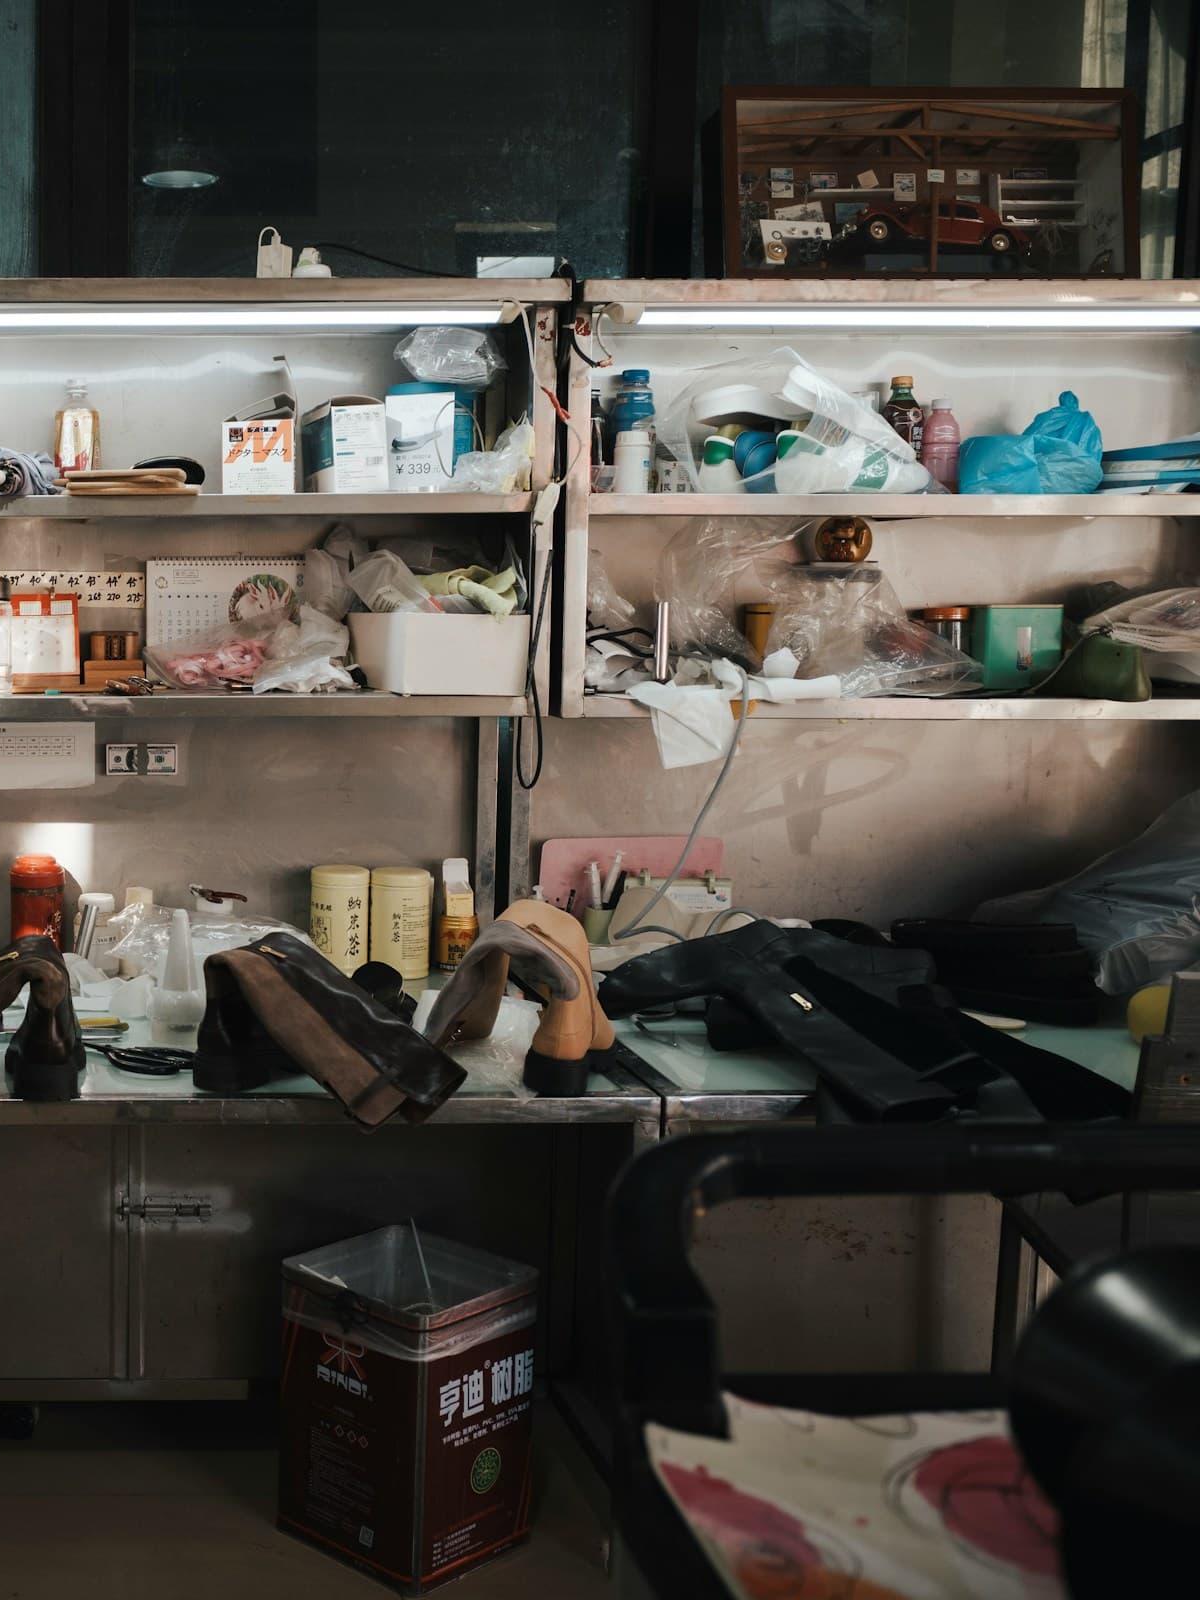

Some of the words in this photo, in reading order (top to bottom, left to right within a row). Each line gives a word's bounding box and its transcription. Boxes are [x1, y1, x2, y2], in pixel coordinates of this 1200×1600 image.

[229, 447, 288, 457] ドクターマスク
[408, 463, 431, 475] 339
[87, 592, 102, 602] 265
[106, 592, 121, 601] 270
[127, 592, 143, 603] 275
